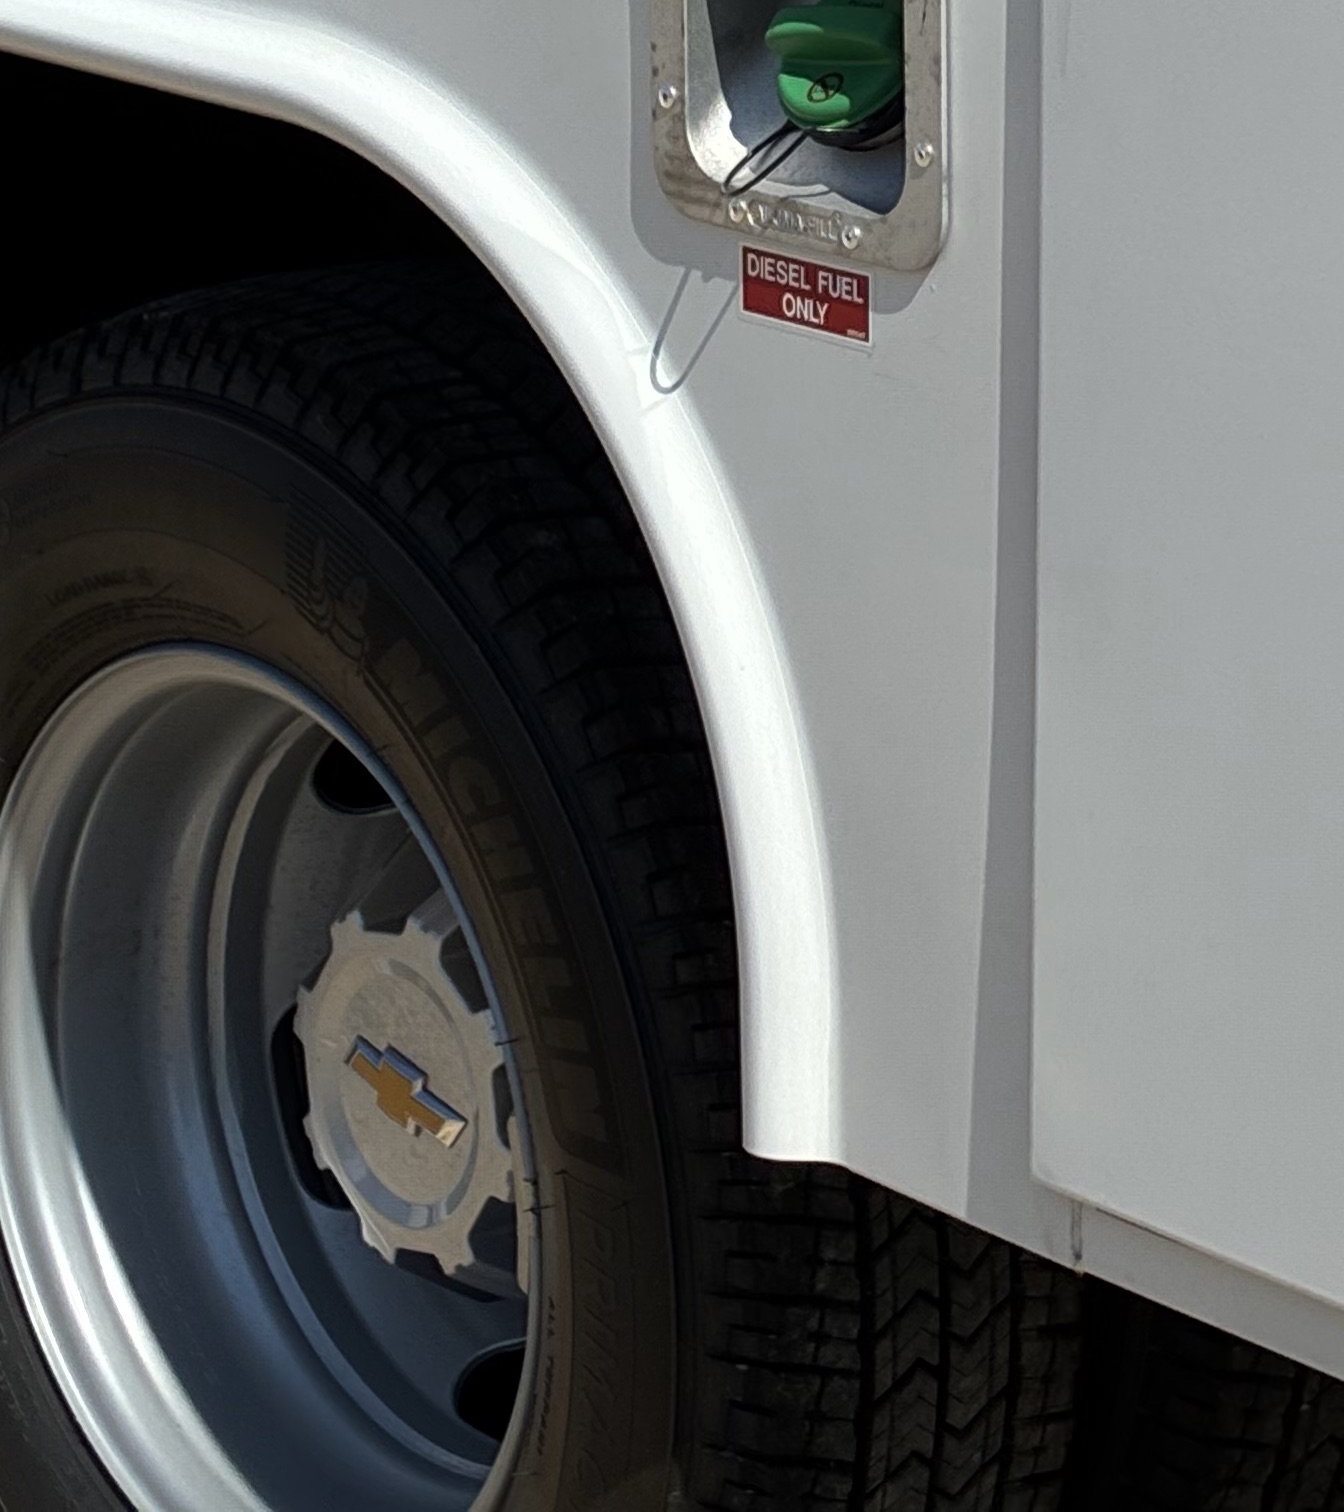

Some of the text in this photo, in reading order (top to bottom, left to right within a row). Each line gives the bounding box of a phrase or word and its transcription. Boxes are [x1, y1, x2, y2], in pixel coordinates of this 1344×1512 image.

[746, 253, 864, 304] DIESEL FUEL
[782, 292, 829, 325] ONLY
[373, 637, 609, 1142] MICHELIN
